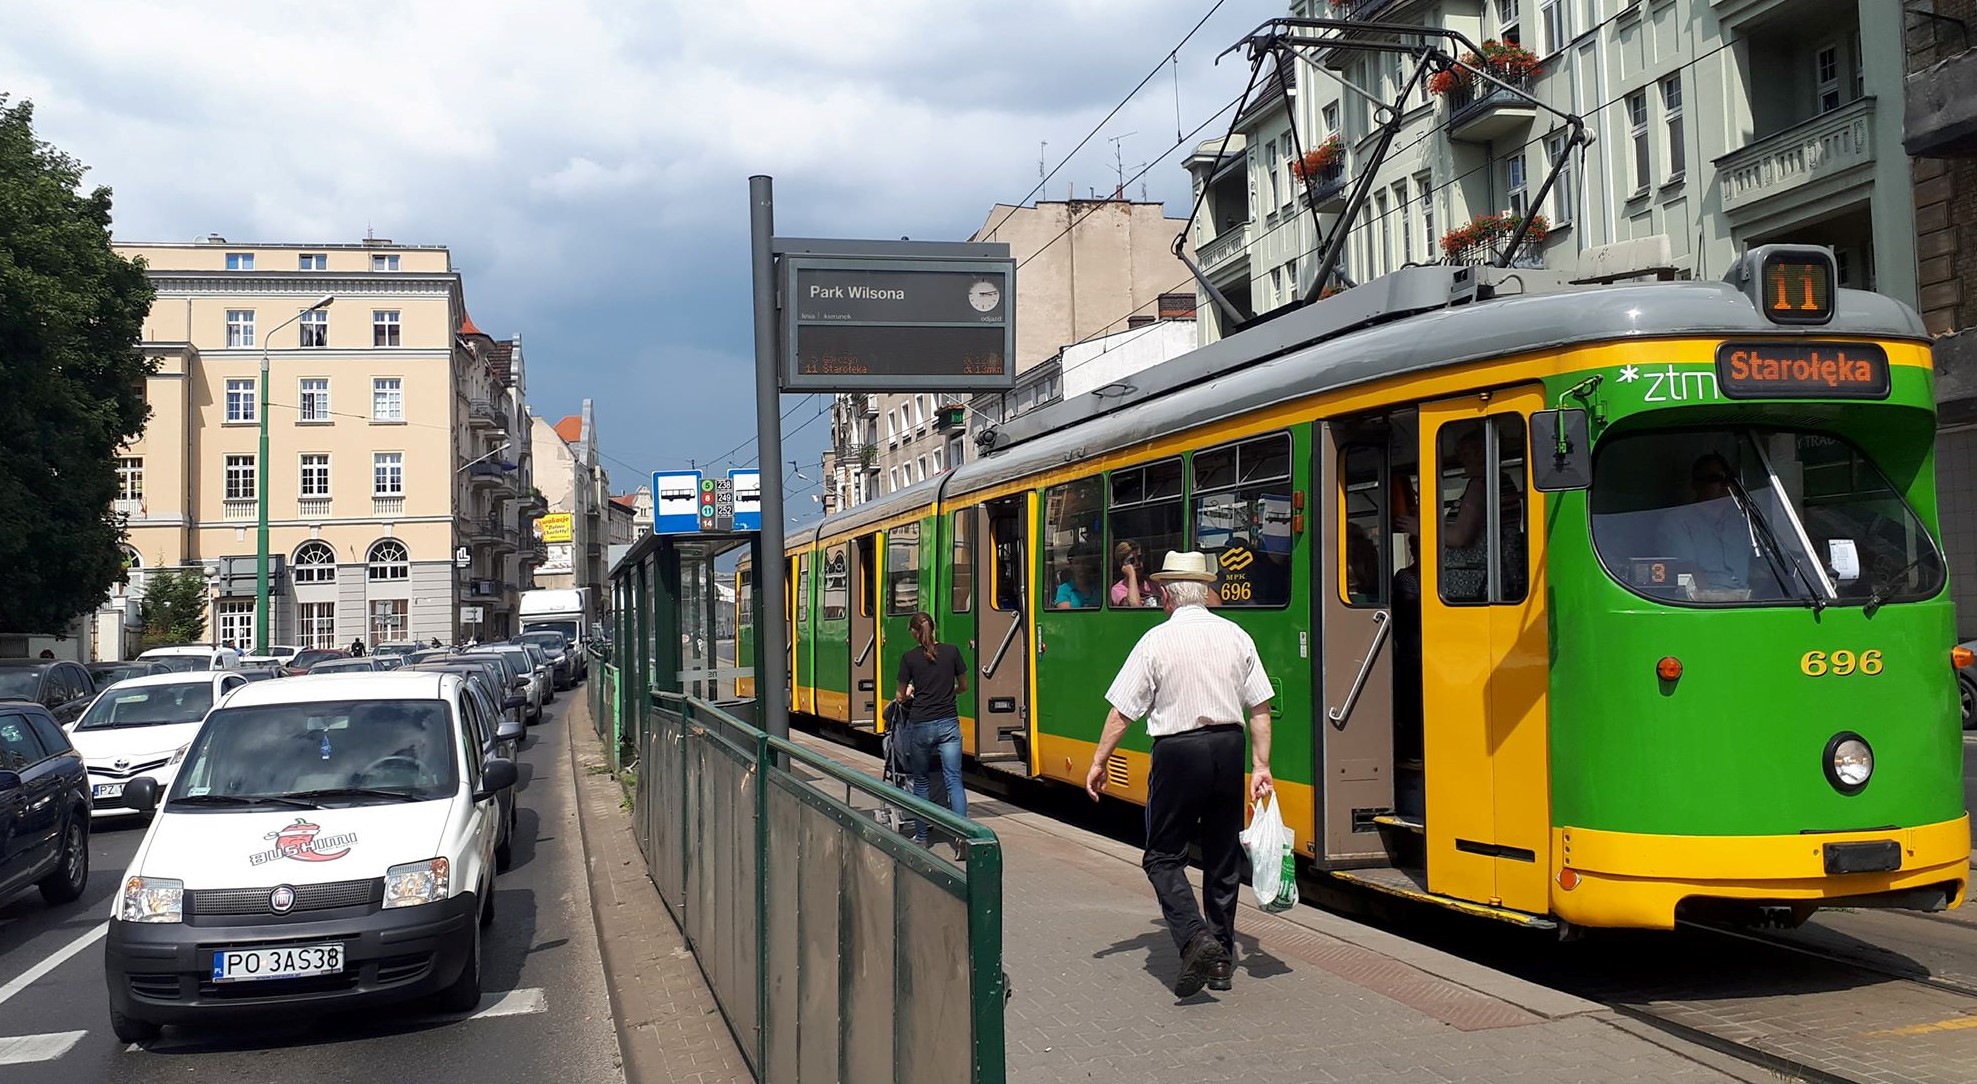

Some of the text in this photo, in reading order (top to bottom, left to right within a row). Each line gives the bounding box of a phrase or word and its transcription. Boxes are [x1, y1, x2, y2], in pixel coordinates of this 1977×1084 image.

[810, 285, 905, 300] Park Wilsona
[1774, 264, 1818, 309] 11
[980, 315, 1002, 323] odjazd
[1730, 350, 1872, 387] Starołęka
[717, 480, 731, 489] 238
[718, 494, 731, 502] 249
[718, 506, 732, 515] 252
[1221, 582, 1252, 600] 696
[1800, 649, 1884, 677] 696
[100, 785, 115, 796] PZ
[249, 832, 358, 867] BUSHIMI
[227, 947, 339, 975] PO 3AS38
